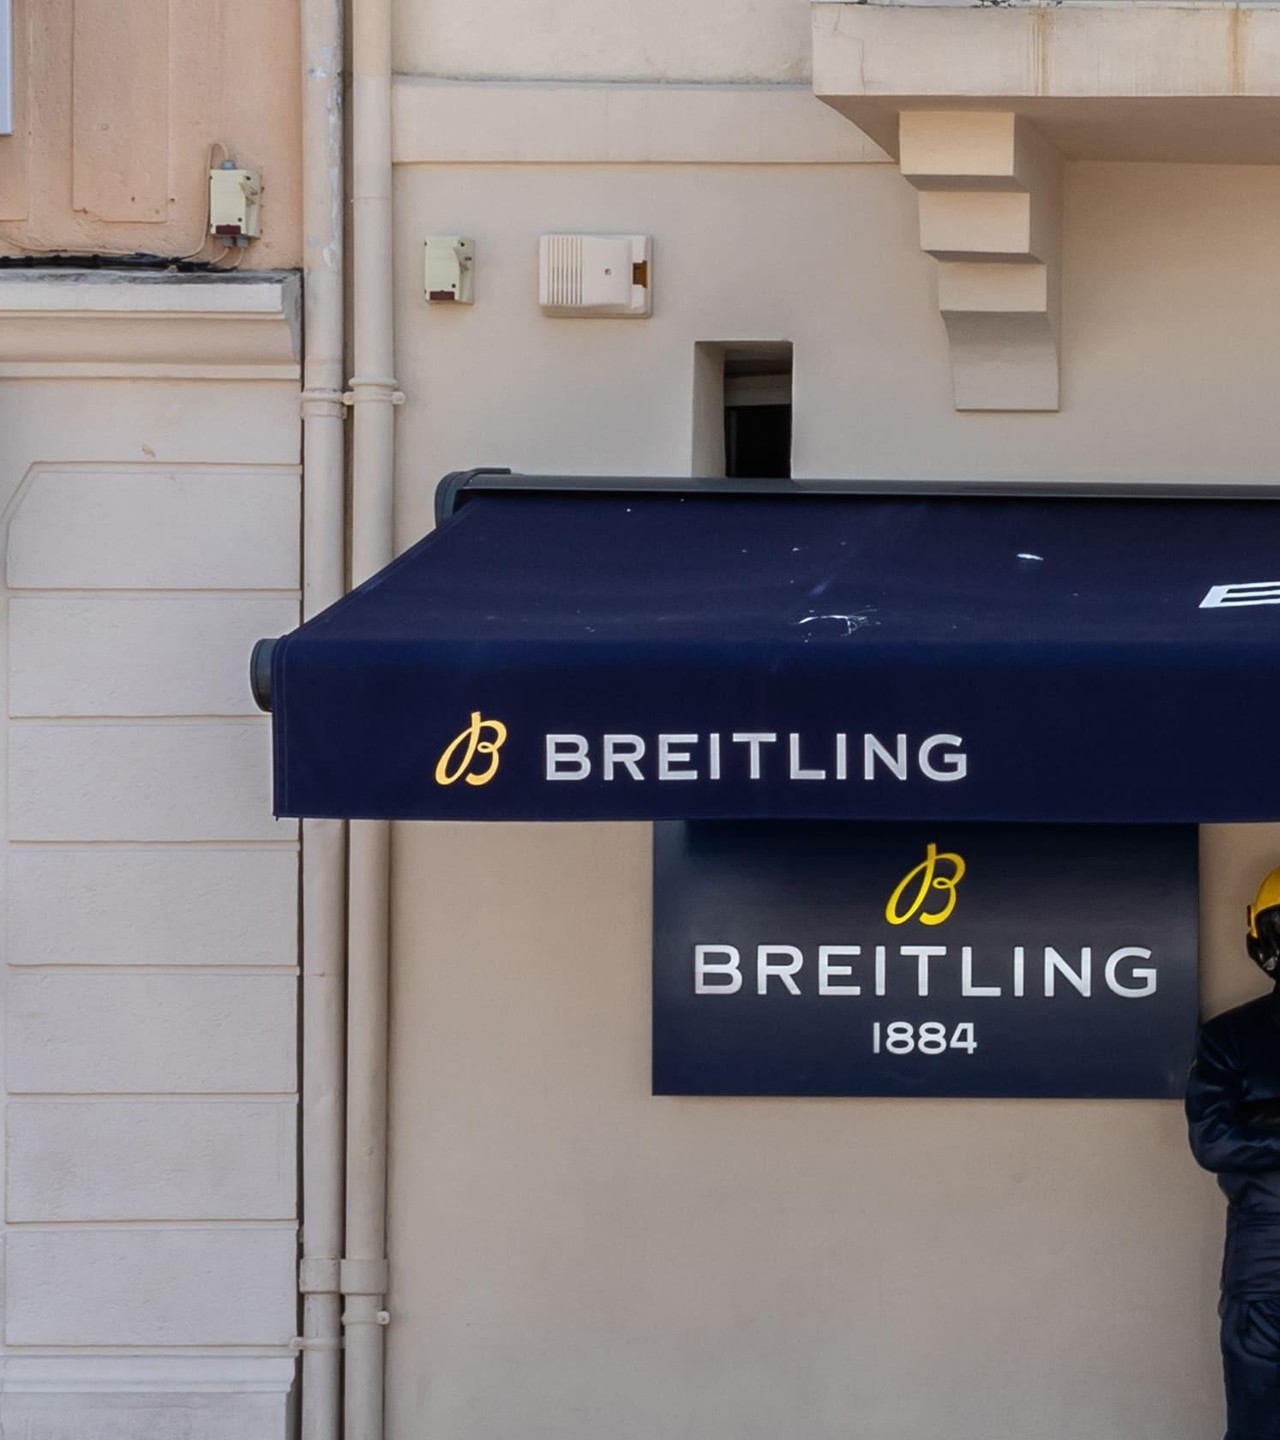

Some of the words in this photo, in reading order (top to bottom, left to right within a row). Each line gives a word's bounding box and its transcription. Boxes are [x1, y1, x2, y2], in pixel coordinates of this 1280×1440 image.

[545, 732, 968, 782] BREITLING
[694, 944, 1158, 998] BREITLING
[873, 1021, 978, 1055] 1884
